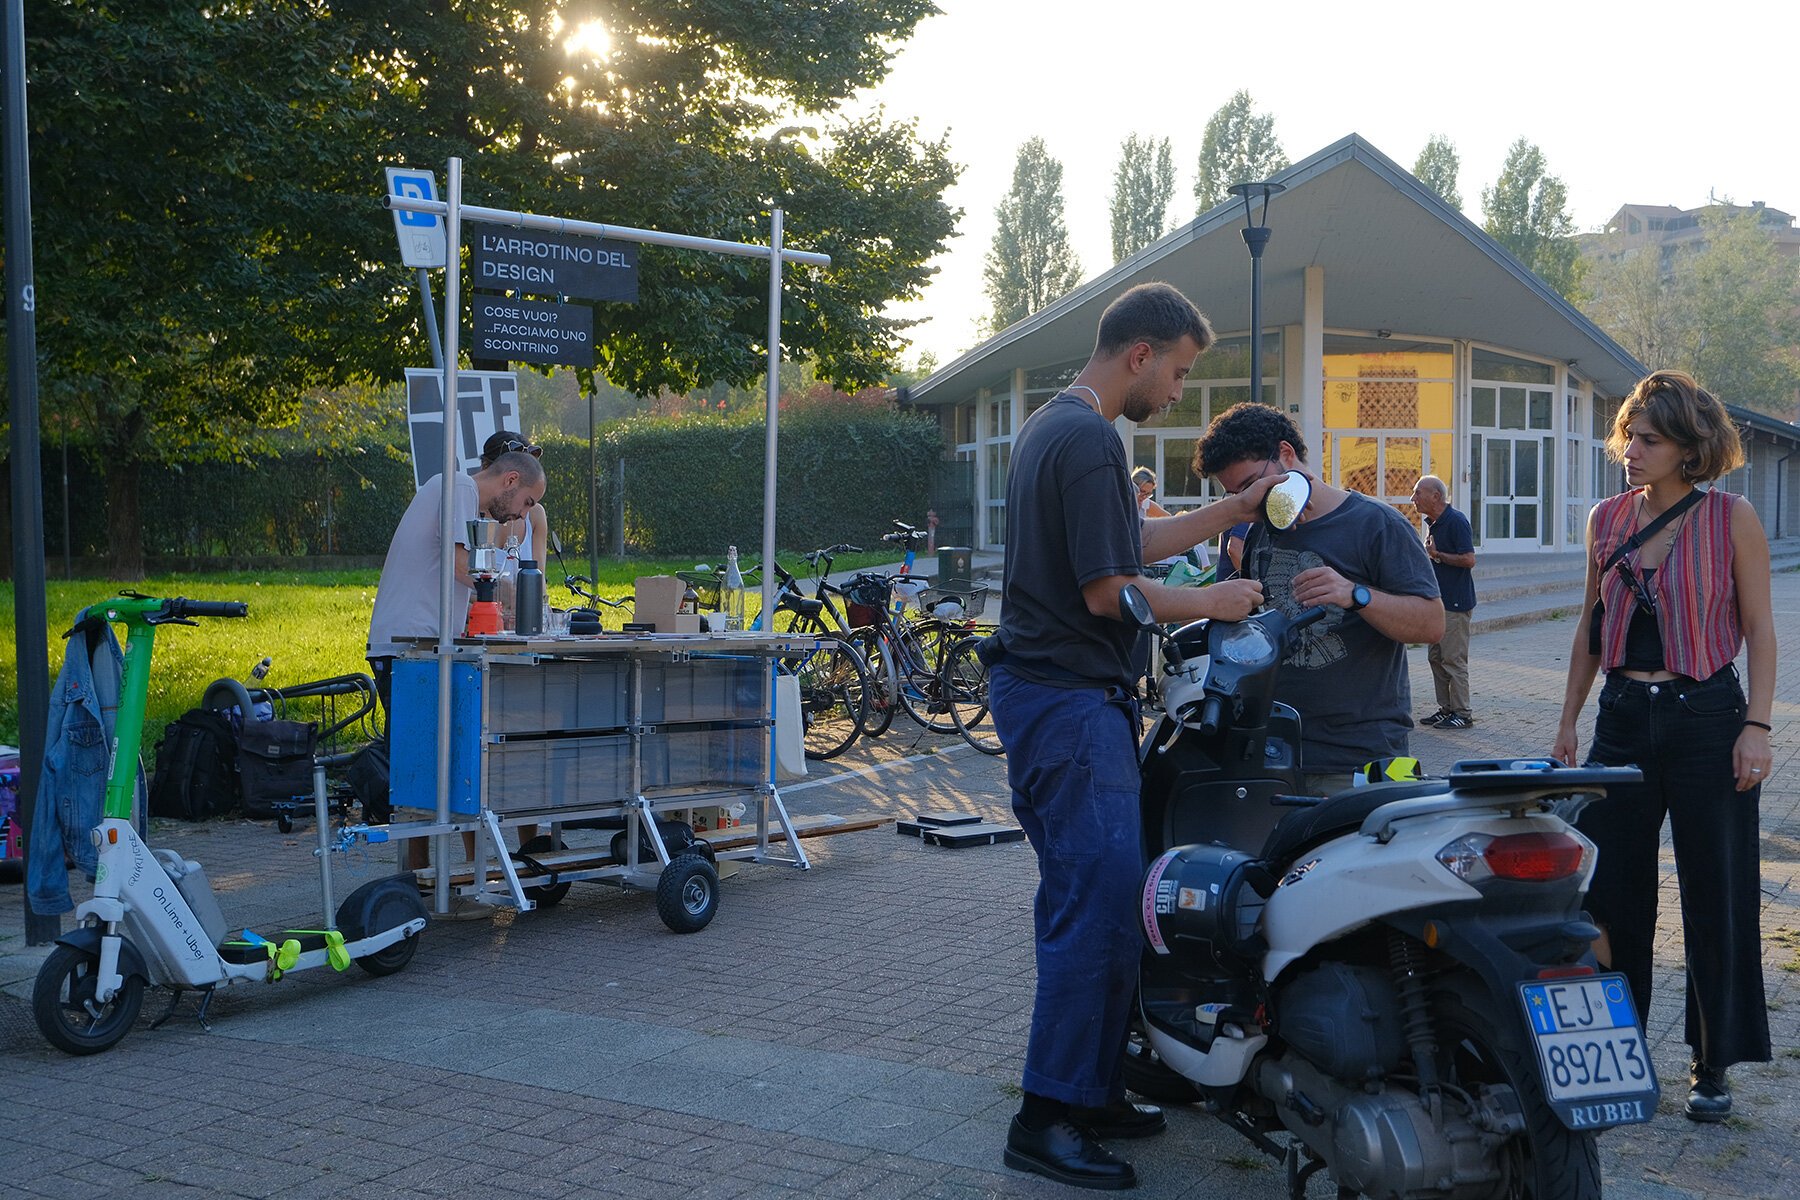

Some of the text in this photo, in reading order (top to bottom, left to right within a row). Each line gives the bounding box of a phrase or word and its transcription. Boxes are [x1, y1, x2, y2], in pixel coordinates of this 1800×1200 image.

[401, 183, 424, 220] P
[482, 235, 631, 268] L'ARROTINO DEL
[482, 261, 554, 284] DESIGN
[484, 306, 558, 323] COSE VUOI?
[484, 323, 587, 342] ...FACCIAMO UNO
[484, 338, 559, 355] SCONTRINO
[153, 887, 167, 905] On
[163, 902, 183, 929] Lime
[185, 935, 205, 961] Uber
[1549, 986, 1594, 1028] EJ
[1549, 1038, 1646, 1088] 89213
[1570, 1101, 1645, 1126] RUBEI
